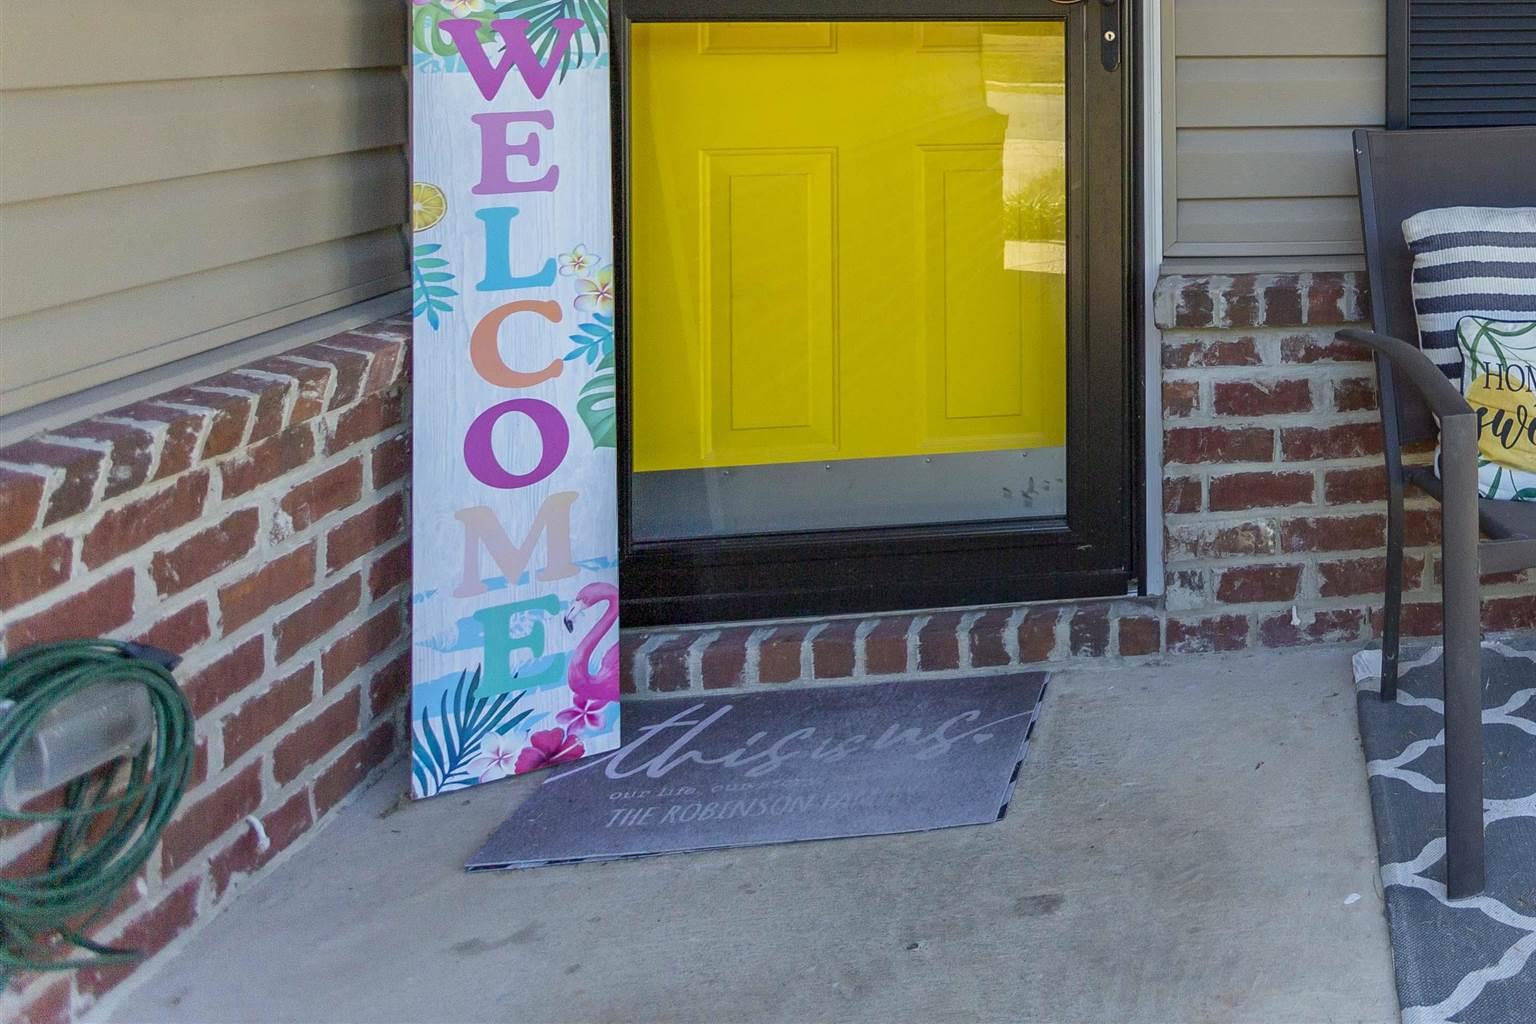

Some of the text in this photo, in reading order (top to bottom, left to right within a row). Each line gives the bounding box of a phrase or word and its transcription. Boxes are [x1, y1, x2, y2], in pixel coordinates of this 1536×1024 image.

[438, 18, 584, 698] WELCOME
[543, 703, 816, 784] this
[811, 734, 868, 763] is
[605, 807, 660, 828] THE
[660, 793, 815, 825] ROBINSON
